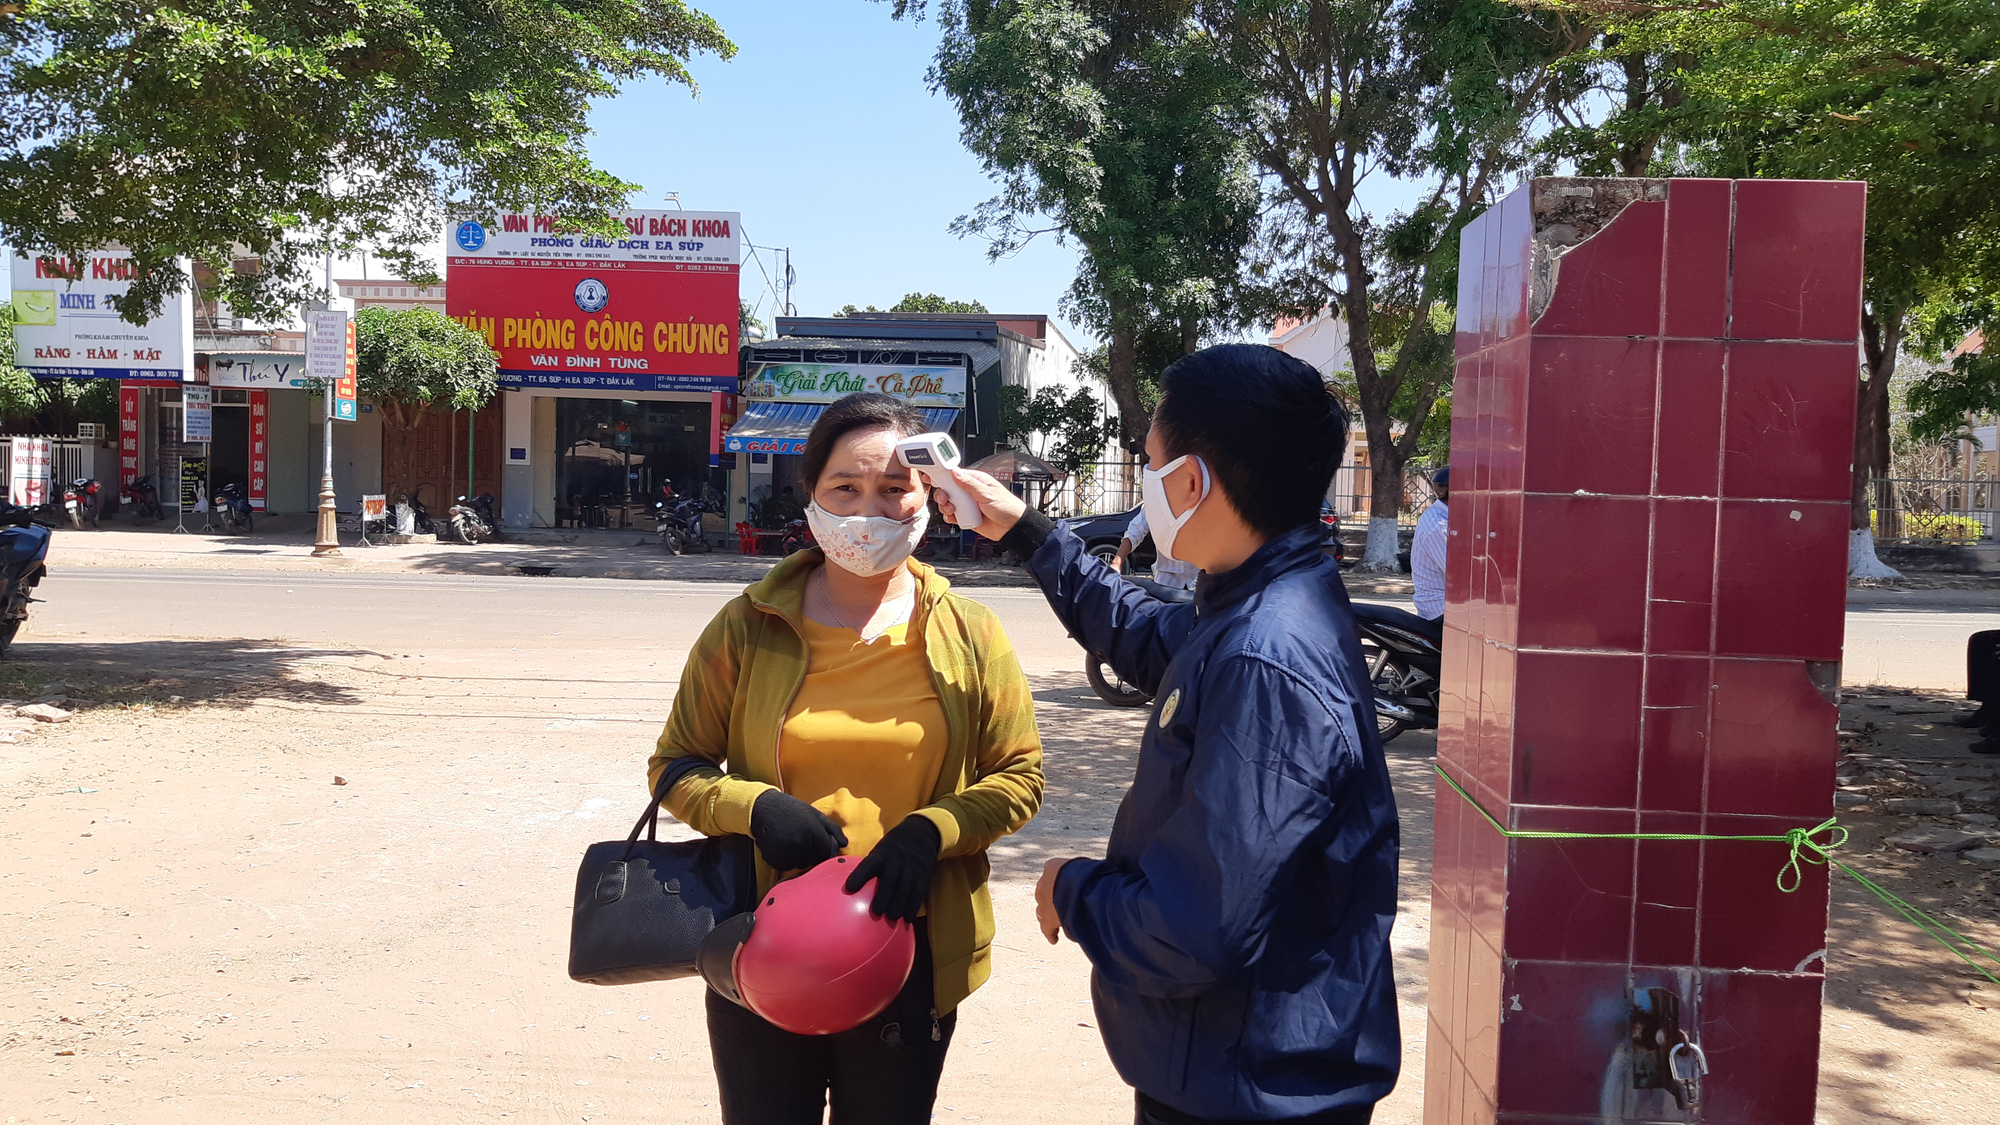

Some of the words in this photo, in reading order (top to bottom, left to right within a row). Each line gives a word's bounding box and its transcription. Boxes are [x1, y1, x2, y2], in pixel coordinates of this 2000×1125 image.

[625, 214, 646, 236] SƯ
[649, 214, 687, 237] BÁCH
[692, 219, 731, 238] KHOA
[580, 238, 612, 249] GIAO
[618, 240, 650, 251] DỊCH
[655, 241, 673, 251] EA
[679, 239, 704, 252] SÚP
[60, 293, 95, 309] MINH
[504, 311, 576, 350] PHÒNG
[585, 313, 644, 352] CÔNG
[653, 316, 730, 355] CHỨNG
[34, 346, 71, 359] RĂNG
[86, 346, 118, 360] HÀM
[133, 347, 162, 362] MẶT
[236, 358, 271, 382] Thú
[274, 363, 290, 382] Y
[530, 355, 559, 367] VĂN
[566, 355, 601, 368] ĐÌNH
[608, 356, 649, 370] TÙNG
[775, 370, 818, 395] Giải
[820, 371, 867, 393] Khát
[876, 373, 903, 394] Cà
[905, 373, 943, 398] Phê
[746, 439, 789, 453] GIẢI
